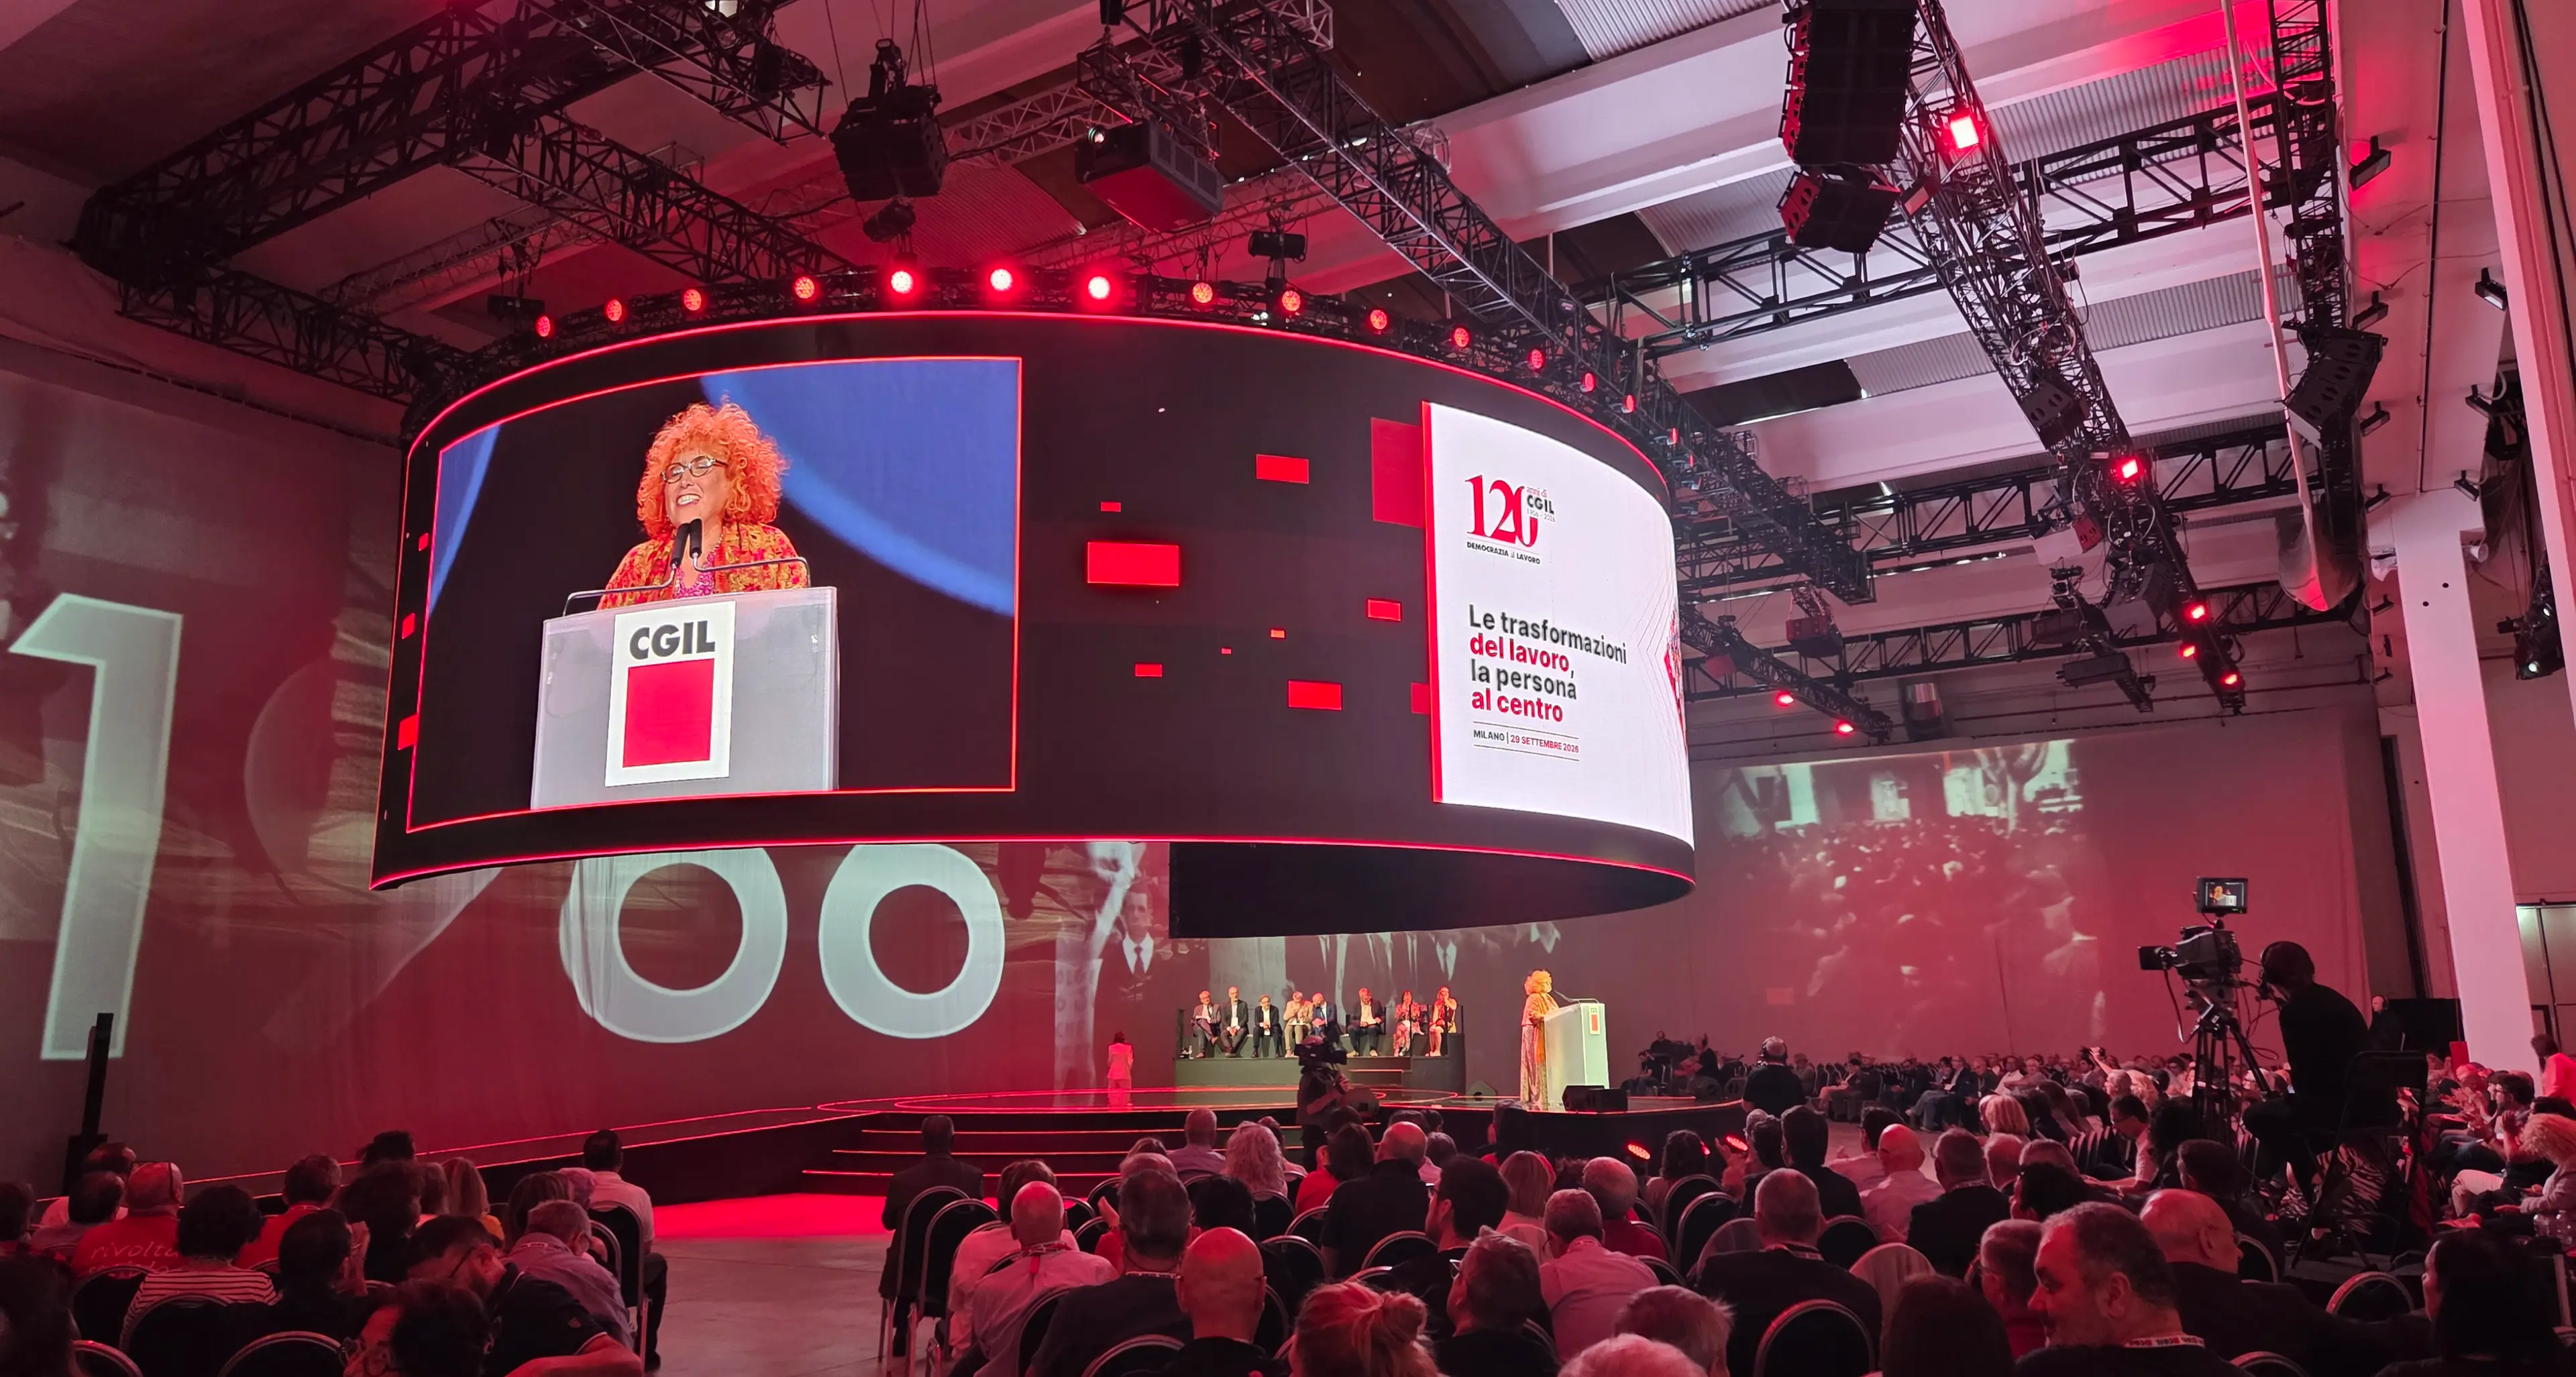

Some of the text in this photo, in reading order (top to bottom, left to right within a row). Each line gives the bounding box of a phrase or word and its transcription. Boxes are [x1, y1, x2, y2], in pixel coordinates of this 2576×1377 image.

[1464, 474, 1538, 547] 120
[1527, 494, 1555, 515] CGIL
[1466, 541, 1509, 557] DEMOCRAZIA
[1516, 552, 1541, 565] LAVORO
[629, 620, 716, 660] CGIL
[1469, 604, 1627, 665] Le trasformazioni
[1470, 632, 1574, 679] del lavoro,
[1471, 658, 1577, 700] la persona
[1472, 687, 1563, 722] al centro
[1473, 729, 1580, 753] MILANO 29 SETTEMBRE 2026
